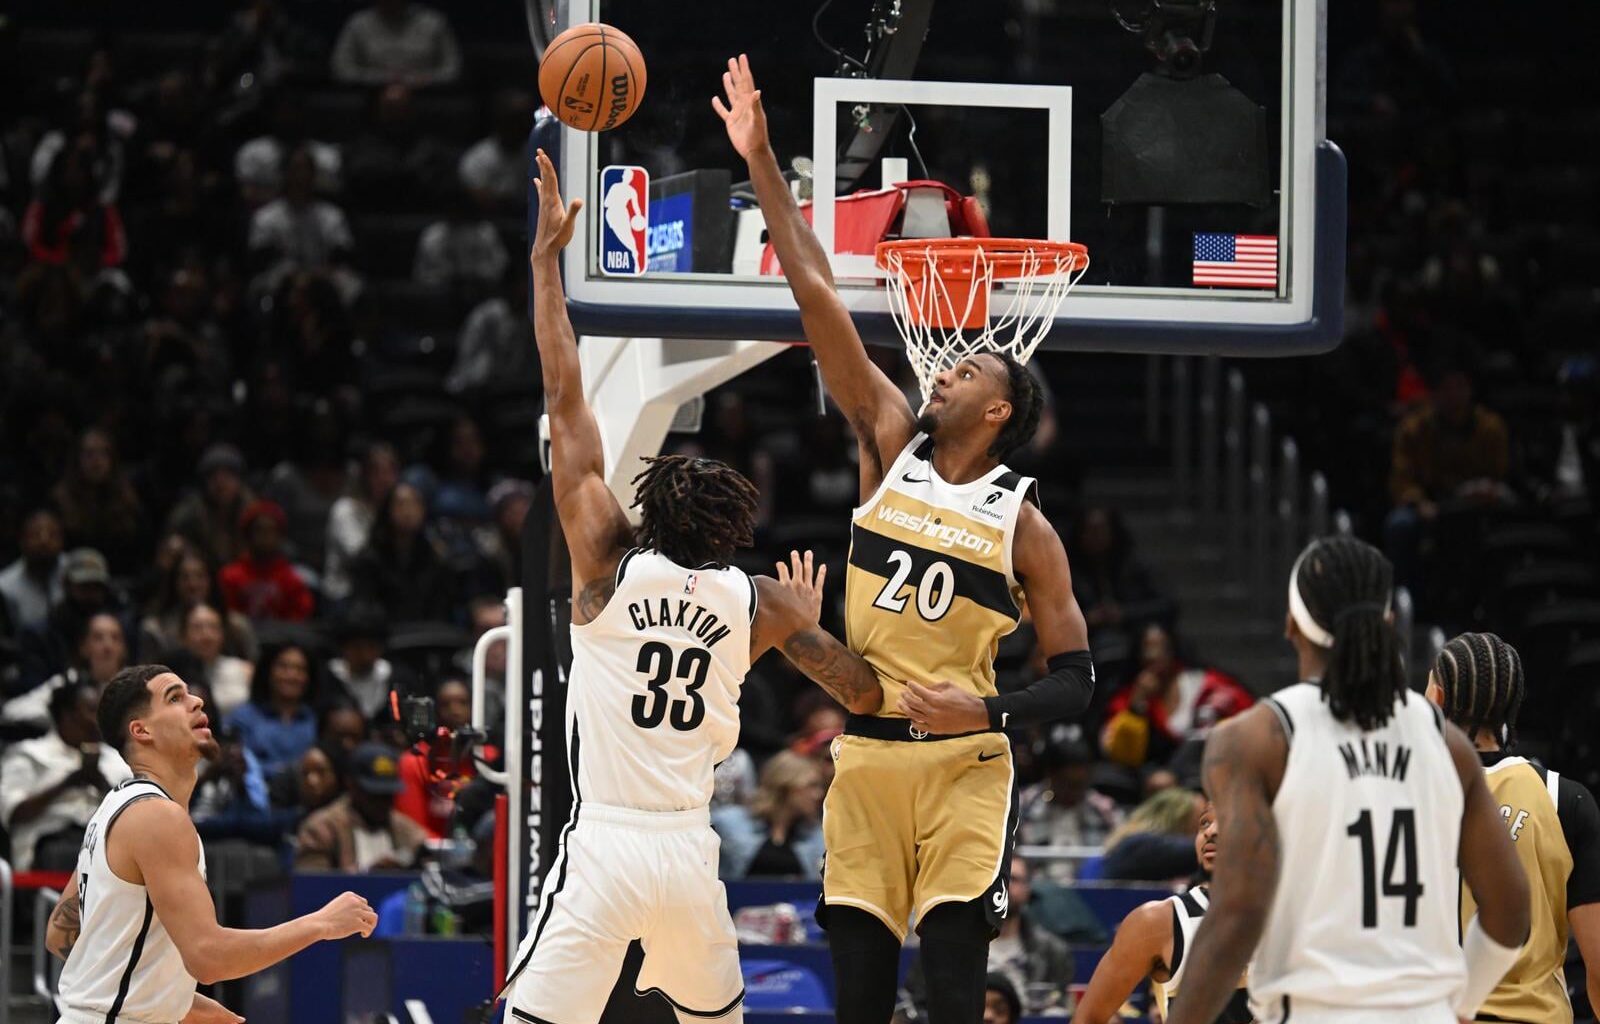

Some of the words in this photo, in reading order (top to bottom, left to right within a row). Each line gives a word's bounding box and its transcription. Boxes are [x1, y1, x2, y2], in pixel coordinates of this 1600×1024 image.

[603, 72, 629, 129] Wilson
[607, 250, 630, 269] NBA
[878, 504, 994, 555] washington
[972, 505, 1004, 520] Robinhood
[872, 550, 955, 623] 20
[628, 598, 731, 649] CLAXTON
[631, 641, 712, 731] 33
[1338, 740, 1411, 782] MANN
[1347, 809, 1424, 928] 14
